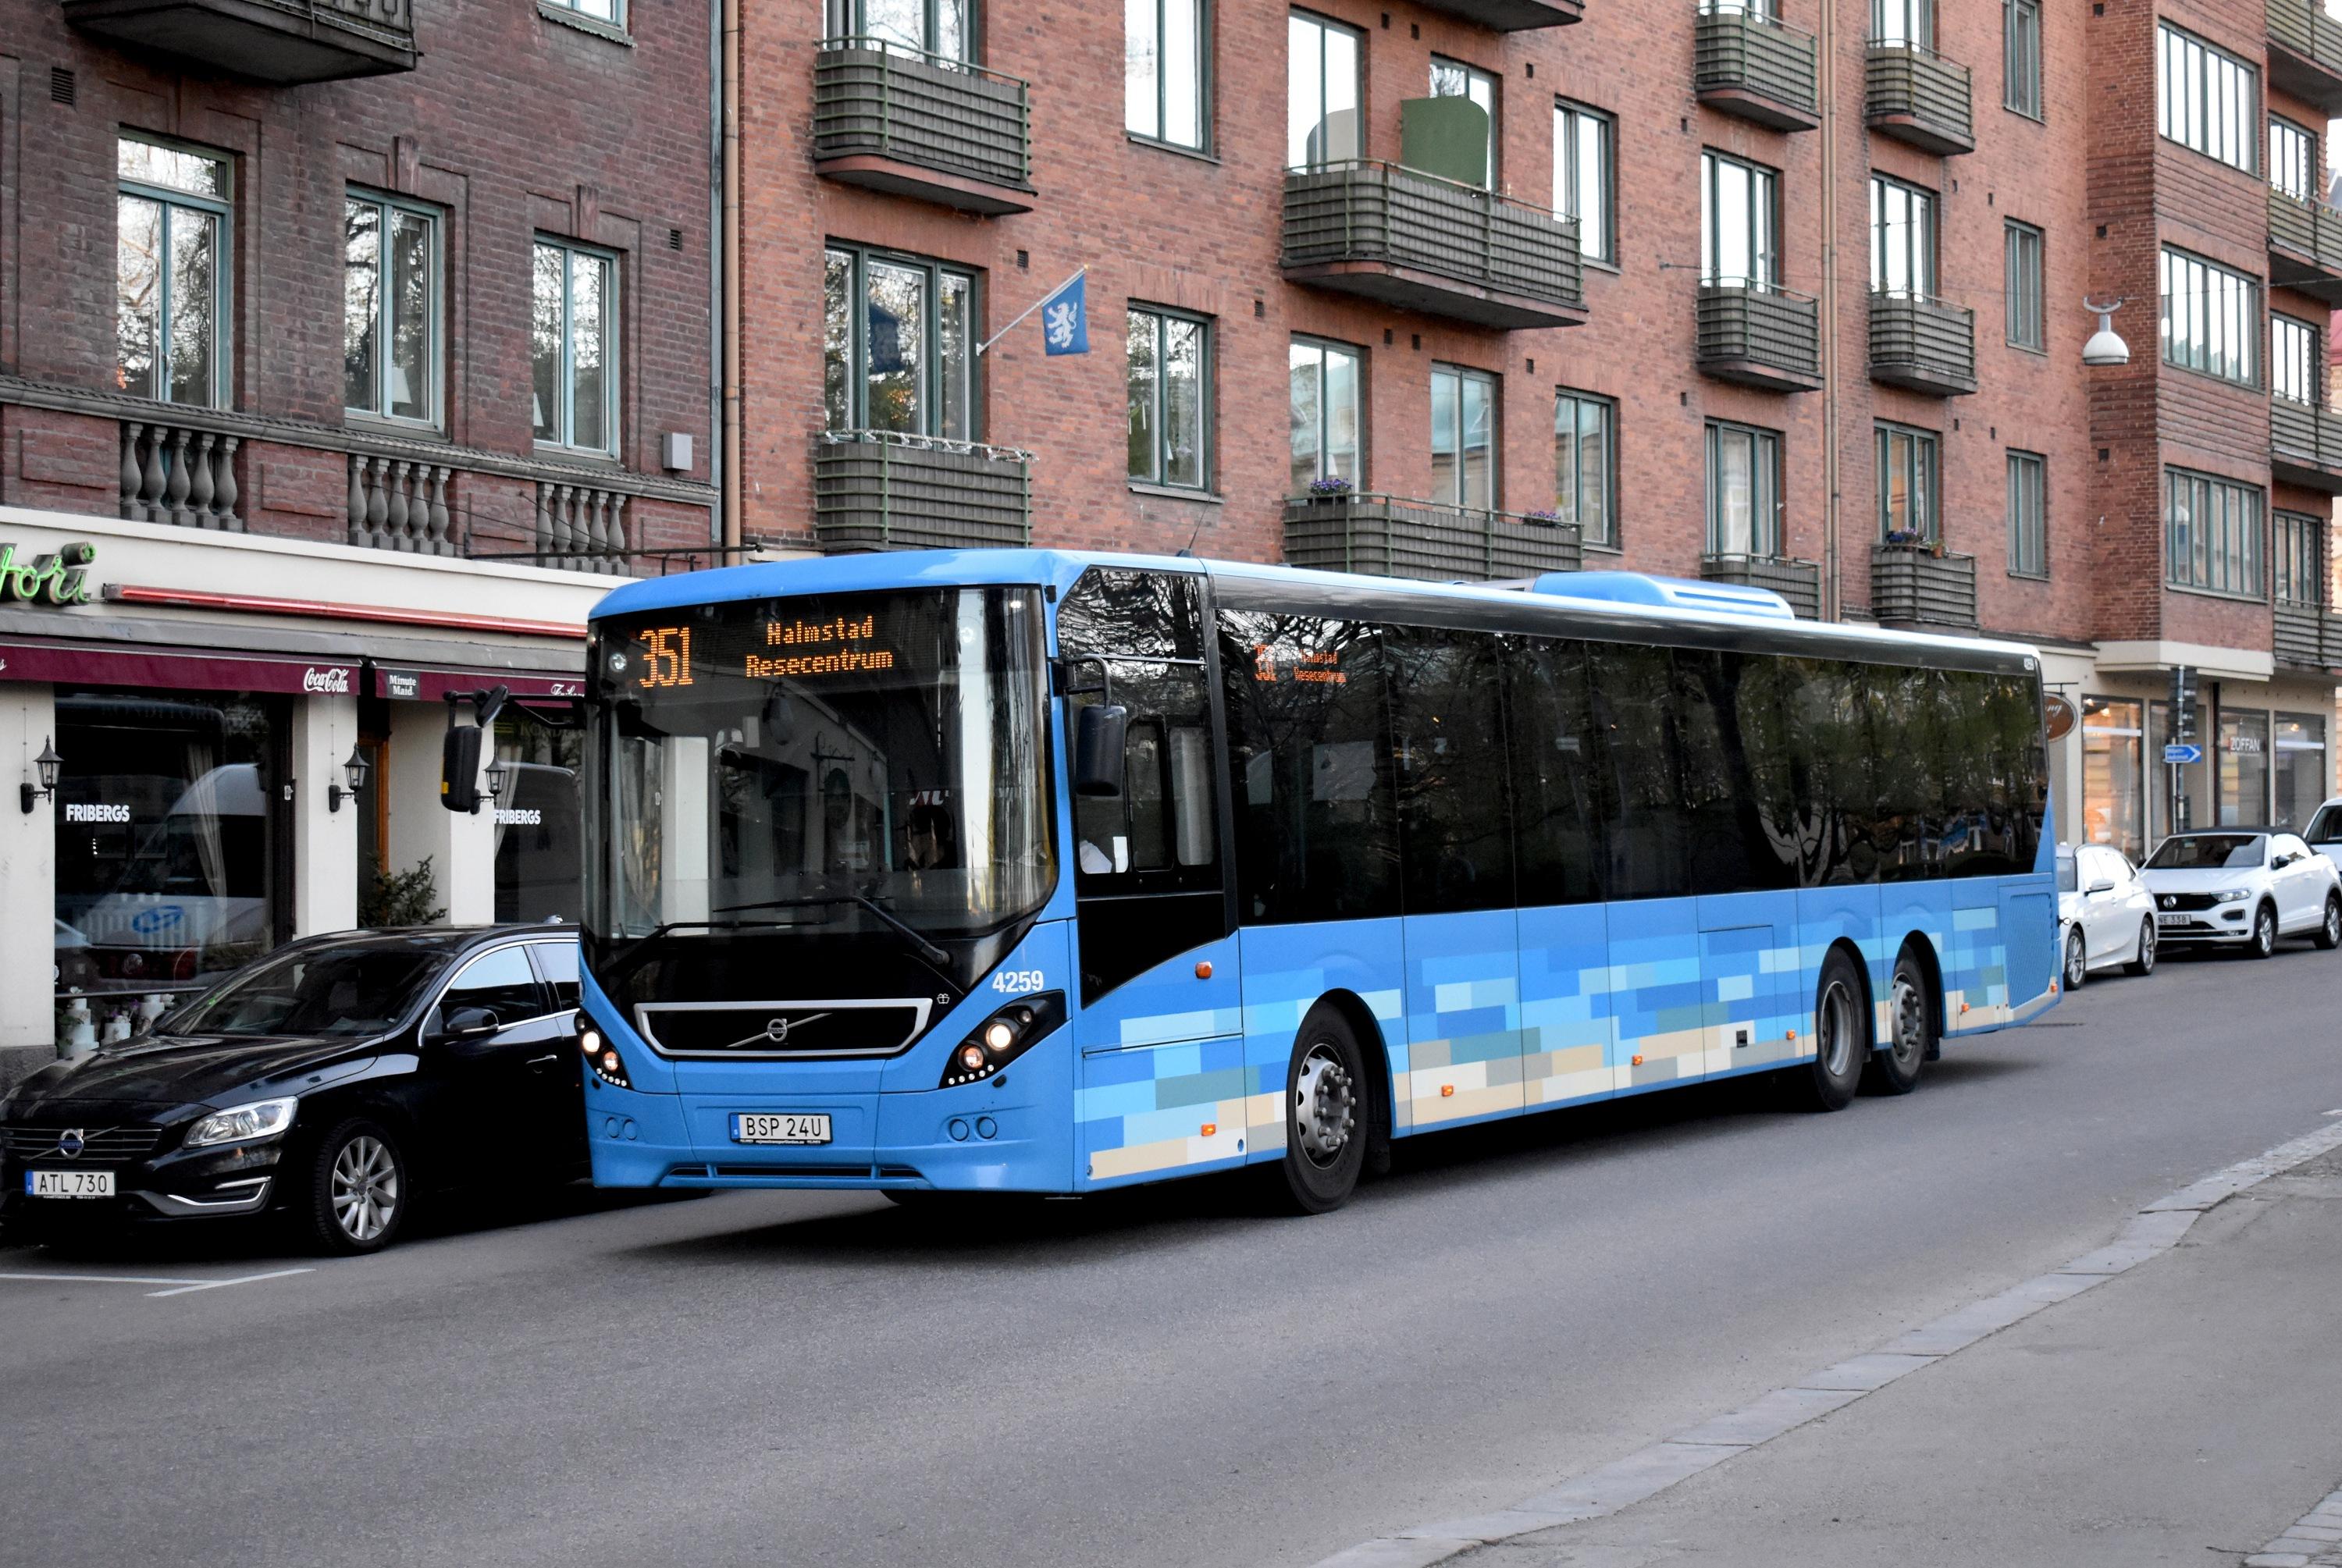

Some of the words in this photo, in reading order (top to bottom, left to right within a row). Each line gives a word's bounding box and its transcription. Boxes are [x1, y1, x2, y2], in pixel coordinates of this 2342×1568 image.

[767, 615, 873, 645] Halmstad
[639, 627, 693, 688] 351
[746, 649, 893, 677] Resecentrum
[303, 667, 349, 692] Coca-Cola
[390, 674, 417, 687] Minute
[393, 685, 414, 695] Maid
[66, 804, 130, 822] FRIBERGS
[493, 809, 541, 825] FRIBERGS
[992, 970, 1044, 992] 4259
[746, 1117, 779, 1136] BSP
[786, 1118, 821, 1136] 24U
[40, 1174, 69, 1193] ATL
[75, 1174, 107, 1193] 730
